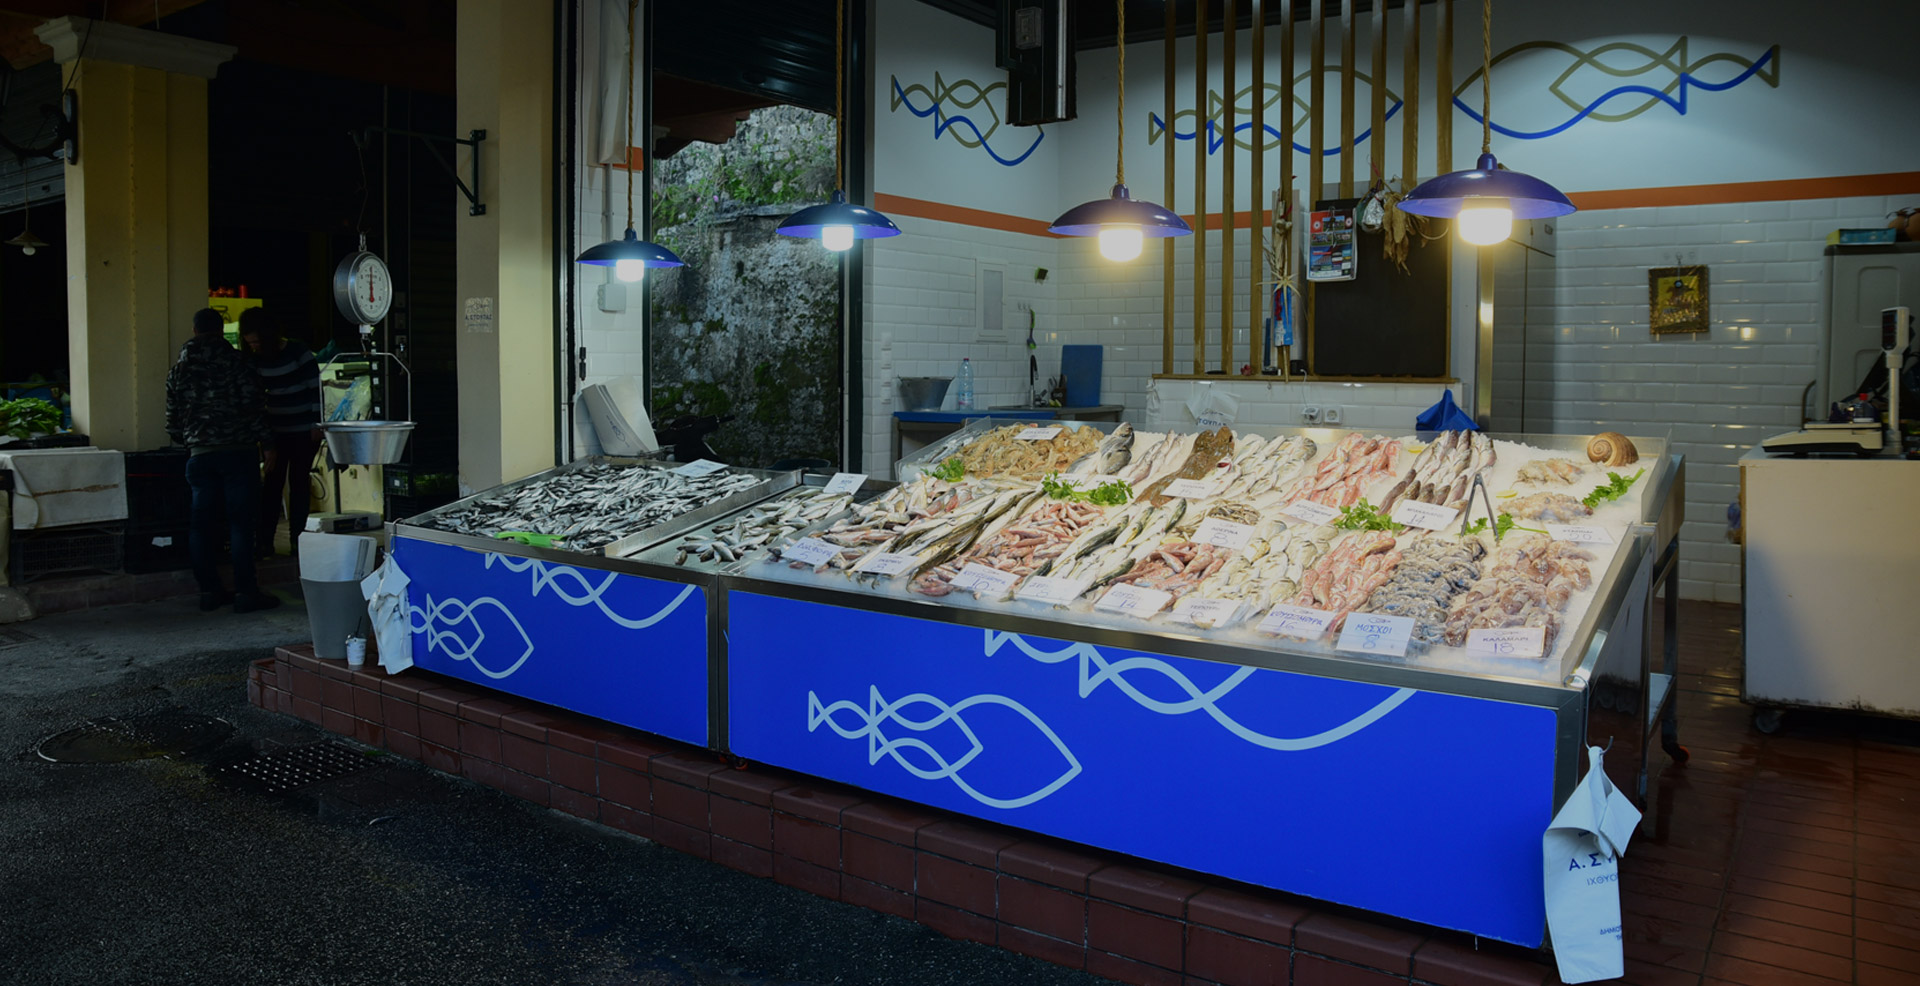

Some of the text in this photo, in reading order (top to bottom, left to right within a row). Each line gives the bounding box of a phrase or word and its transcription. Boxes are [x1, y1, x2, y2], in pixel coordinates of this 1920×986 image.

[1210, 532, 1229, 545] 8
[1354, 623, 1393, 635] ΜΟΣΧΟΙ
[1362, 634, 1381, 650] 8
[1493, 642, 1515, 655] 18
[1586, 872, 1619, 887] ΙΧΘΥΟ
